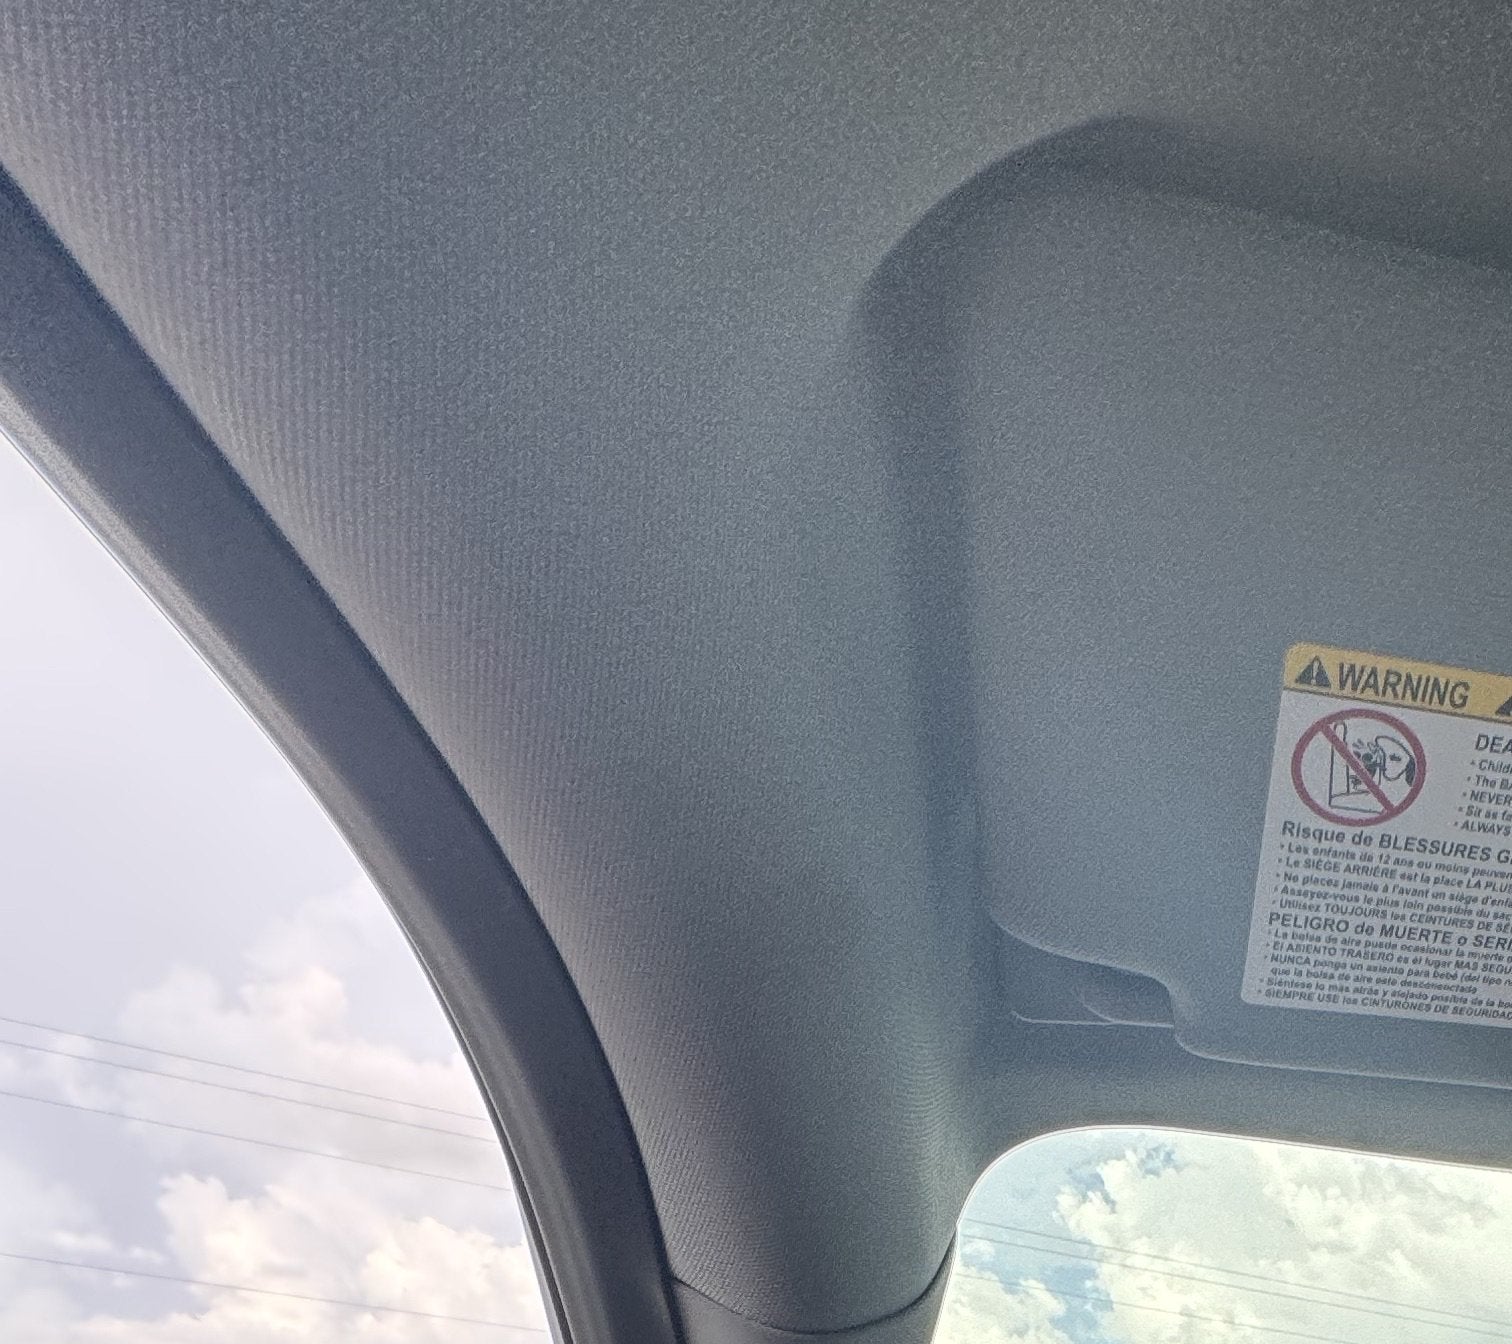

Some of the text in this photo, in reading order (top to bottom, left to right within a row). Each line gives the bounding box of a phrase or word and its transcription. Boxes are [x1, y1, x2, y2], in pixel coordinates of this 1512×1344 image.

[1338, 662, 1470, 708] WARNING
[1475, 775, 1496, 788] The
[1470, 790, 1512, 806] NEVER
[1466, 806, 1481, 817] Sit
[1485, 811, 1498, 819] as
[1461, 821, 1510, 837] ALWAYS
[1282, 821, 1345, 844] Risque
[1351, 830, 1373, 847] de
[1379, 832, 1492, 862] BLESSURES
[1269, 912, 1349, 933] PELIGRO
[1355, 922, 1374, 936] de
[1380, 924, 1453, 945] MUERTE
[1457, 936, 1467, 946] o
